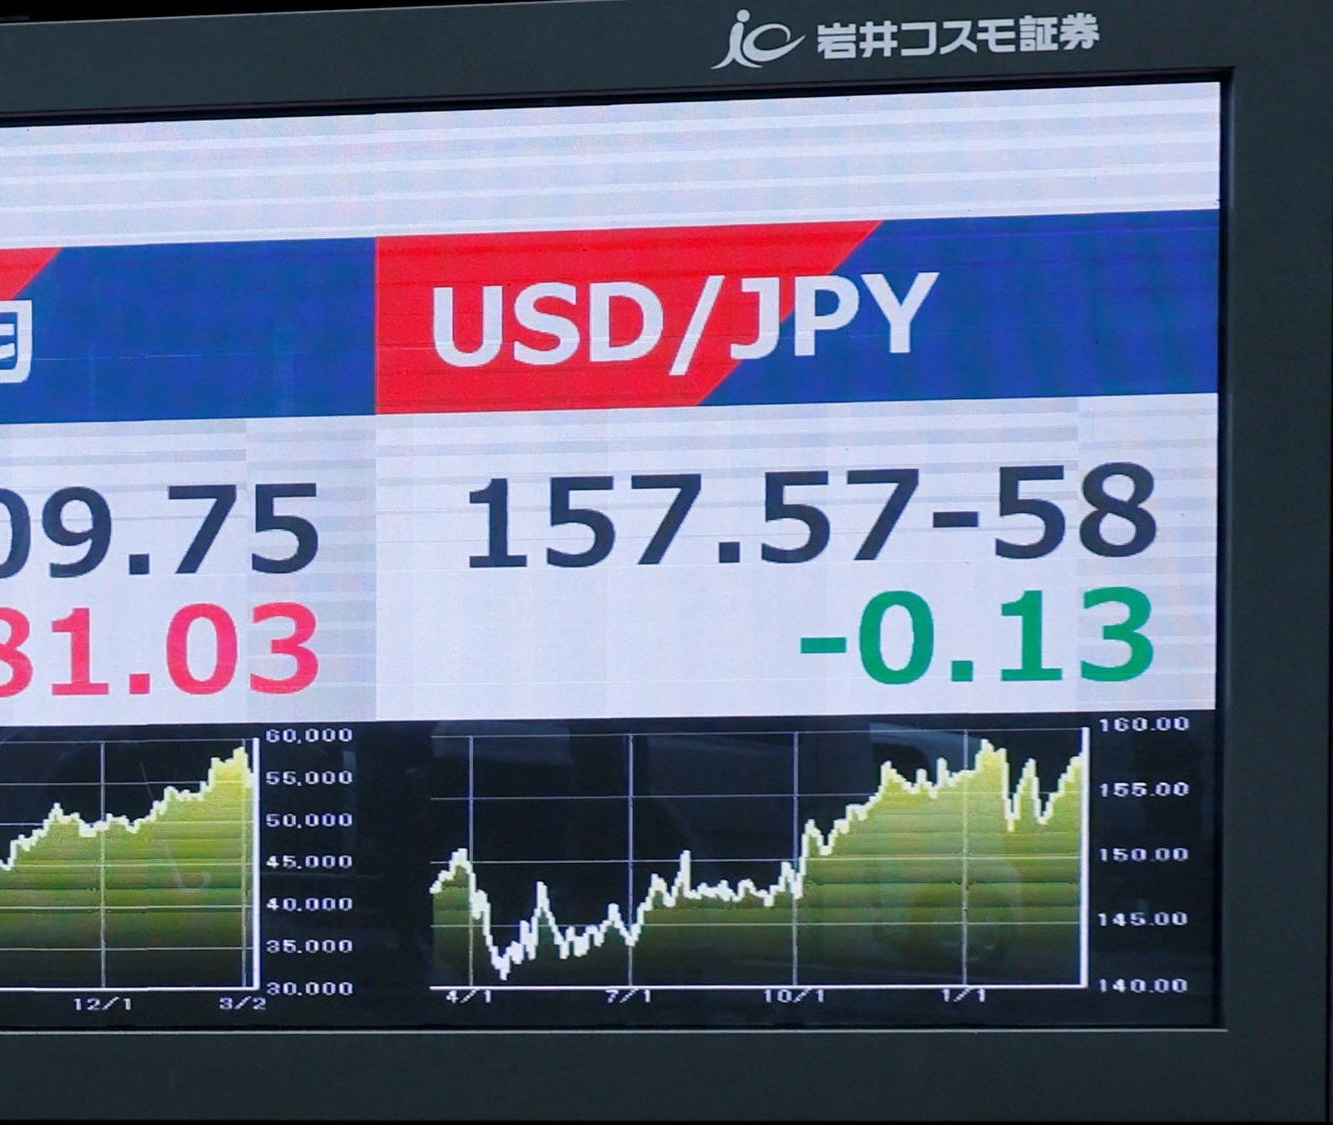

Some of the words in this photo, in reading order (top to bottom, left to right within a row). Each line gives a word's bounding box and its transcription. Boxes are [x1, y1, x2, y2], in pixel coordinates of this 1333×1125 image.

[818, 13, 1099, 59] 岩井コスモ証券
[434, 273, 939, 375] USD/JPY
[470, 463, 1156, 568] 157.57-58
[800, 587, 1155, 685] -0.13
[1099, 716, 1190, 732] 160.00
[1100, 781, 1189, 798] 155.00
[1100, 847, 1189, 862] 150.00
[1098, 911, 1188, 927] 145.00
[1099, 978, 1188, 993] 140.00
[74, 996, 131, 1011] 12/1
[219, 995, 267, 1010] 3/2
[445, 989, 492, 1004] 4/1
[604, 989, 651, 1003] 7/1
[764, 988, 824, 1003] 10/1
[942, 988, 986, 1003] 1/1
